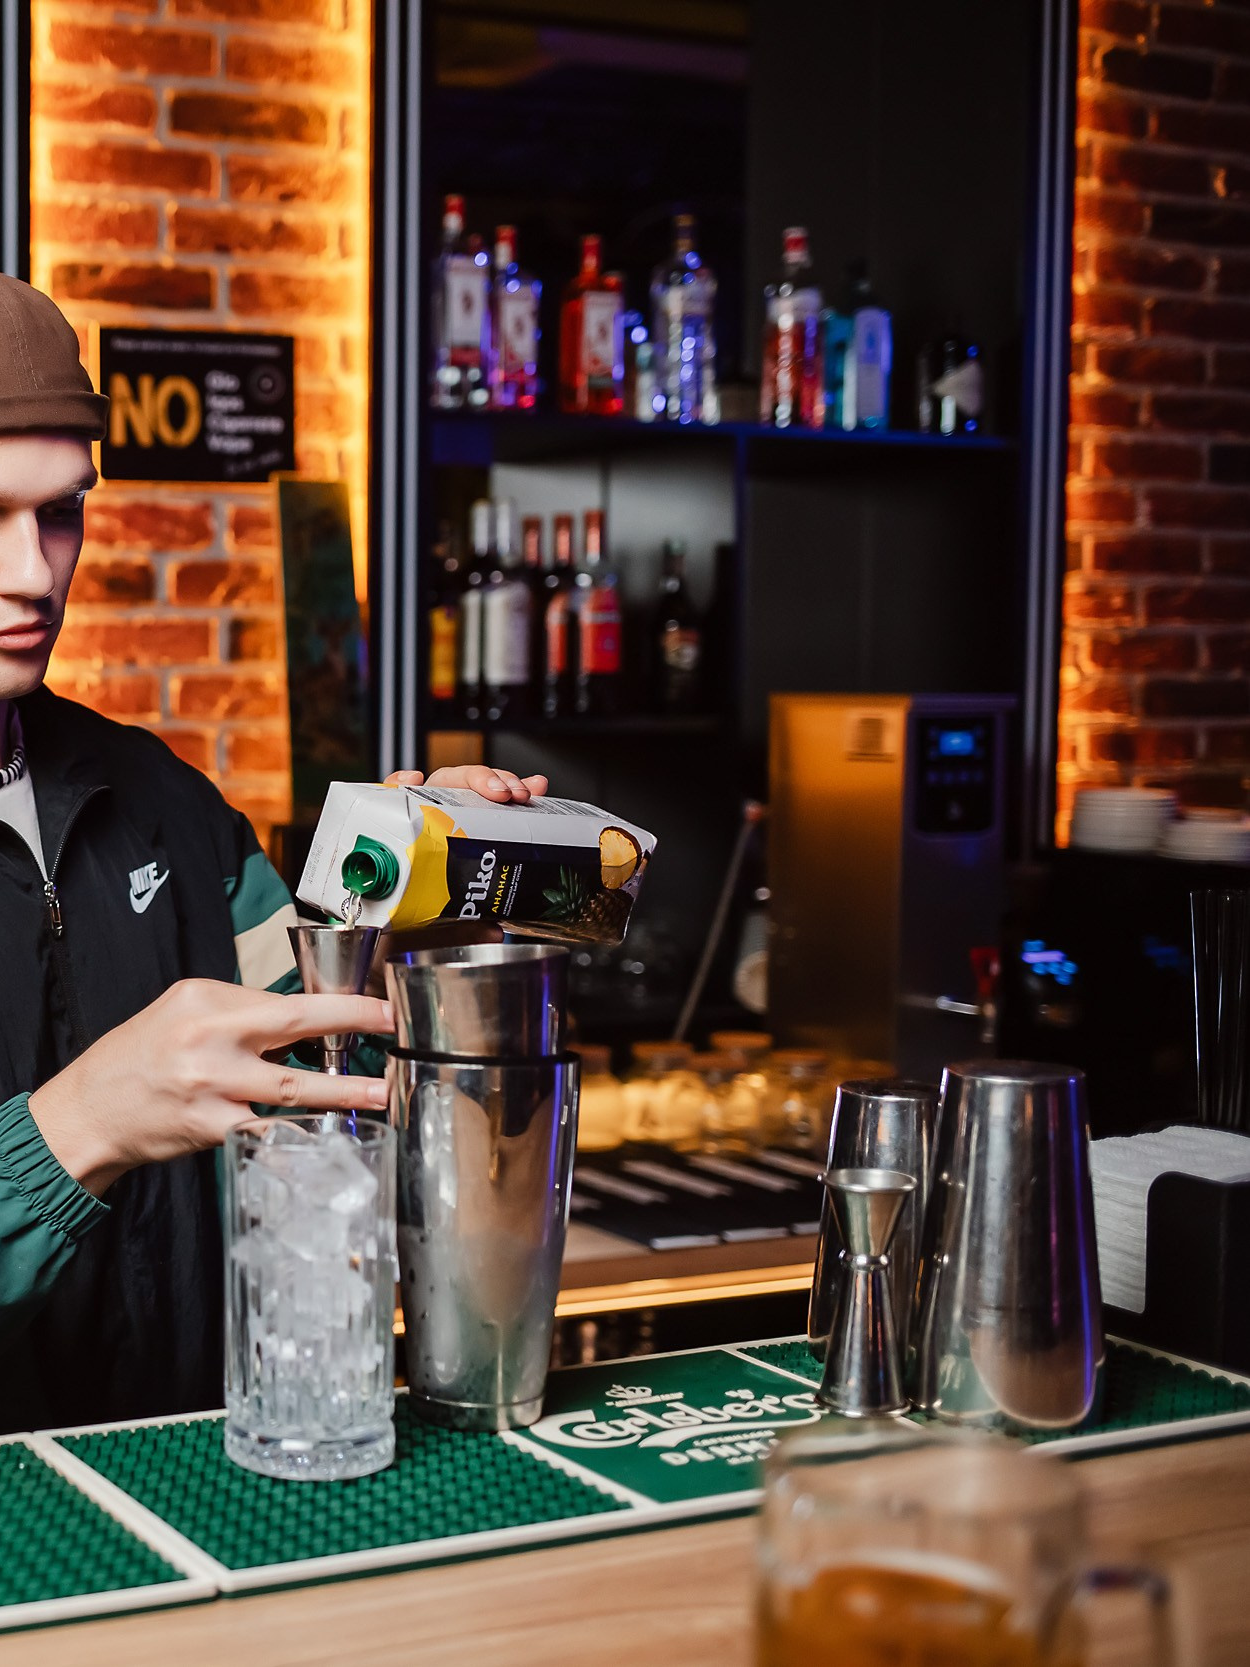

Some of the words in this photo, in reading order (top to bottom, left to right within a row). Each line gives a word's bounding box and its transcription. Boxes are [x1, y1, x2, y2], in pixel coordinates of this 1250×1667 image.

[110, 372, 201, 448] NO
[129, 861, 158, 896] NIKE
[491, 865, 510, 913] АНАНАС
[530, 1388, 828, 1448] Carlsberg
